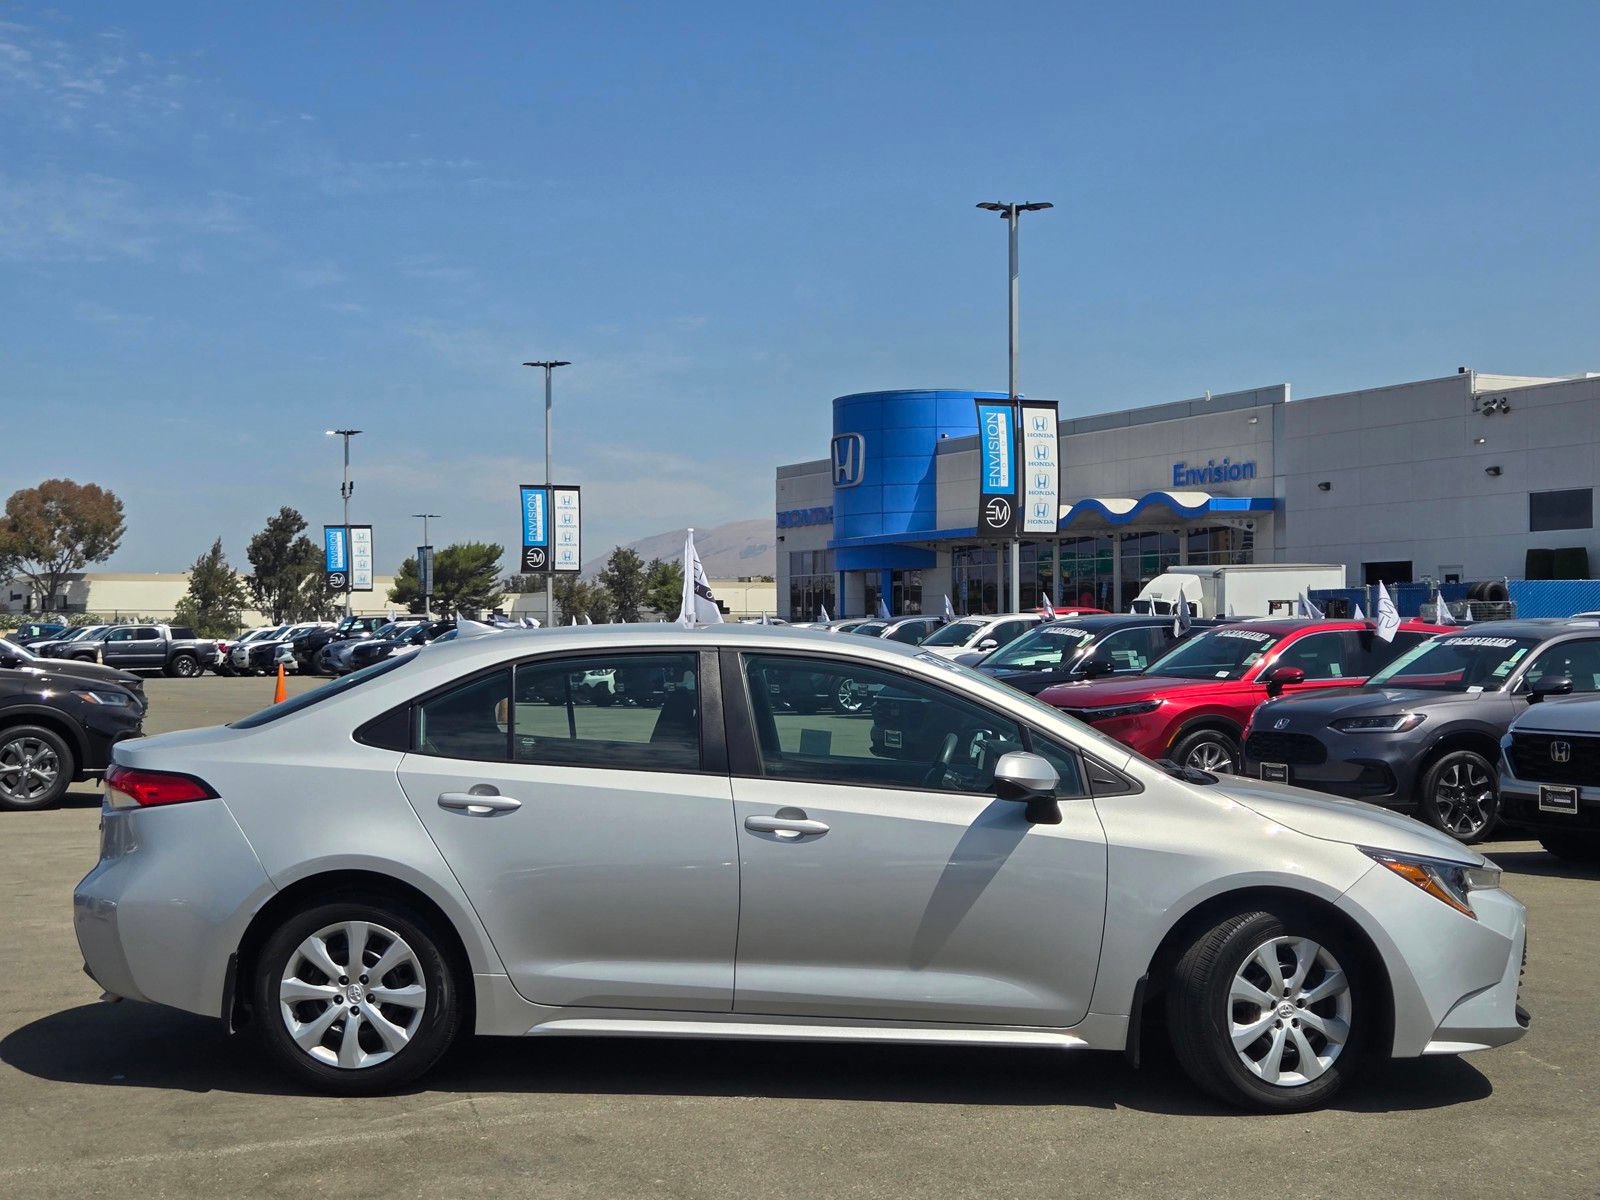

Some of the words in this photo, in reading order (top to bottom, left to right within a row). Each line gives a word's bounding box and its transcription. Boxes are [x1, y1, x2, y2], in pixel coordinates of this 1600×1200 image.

[986, 412, 1000, 487] ENVISION
[1173, 458, 1256, 487] Envision
[528, 493, 537, 542] ENVISION
[330, 531, 338, 569] ENVISION
